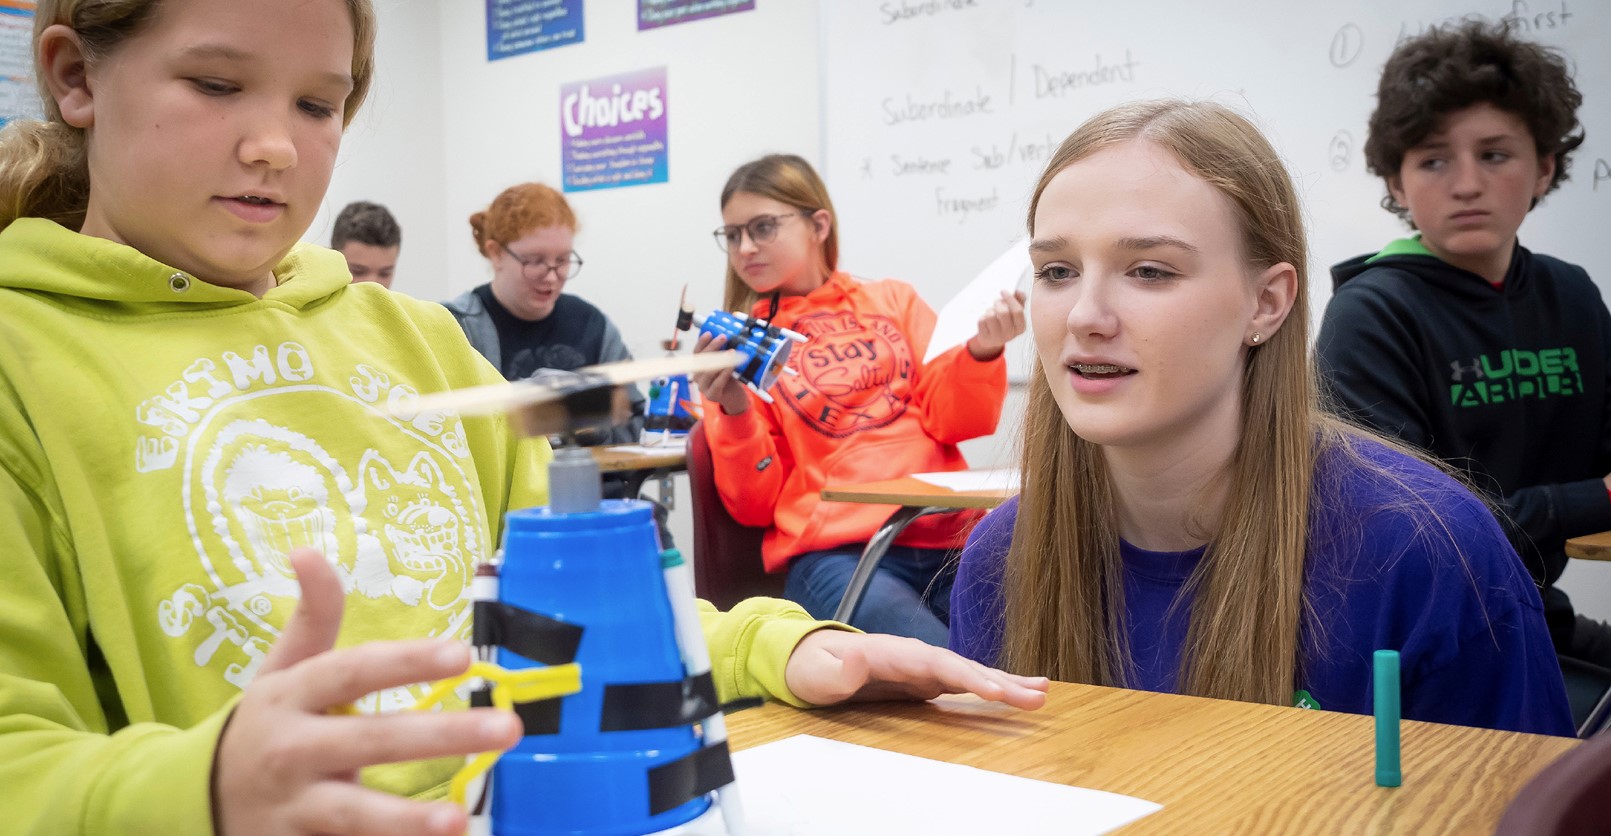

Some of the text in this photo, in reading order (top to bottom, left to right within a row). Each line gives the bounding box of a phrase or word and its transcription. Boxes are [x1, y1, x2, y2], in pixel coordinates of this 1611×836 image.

[881, 86, 994, 126] Subordinate
[1031, 49, 1141, 99] Dependent
[563, 84, 664, 136] Choices
[935, 187, 1000, 223] Fragment
[808, 338, 877, 367] Stay
[814, 365, 891, 396] Salty
[136, 341, 314, 473] ESKIMO
